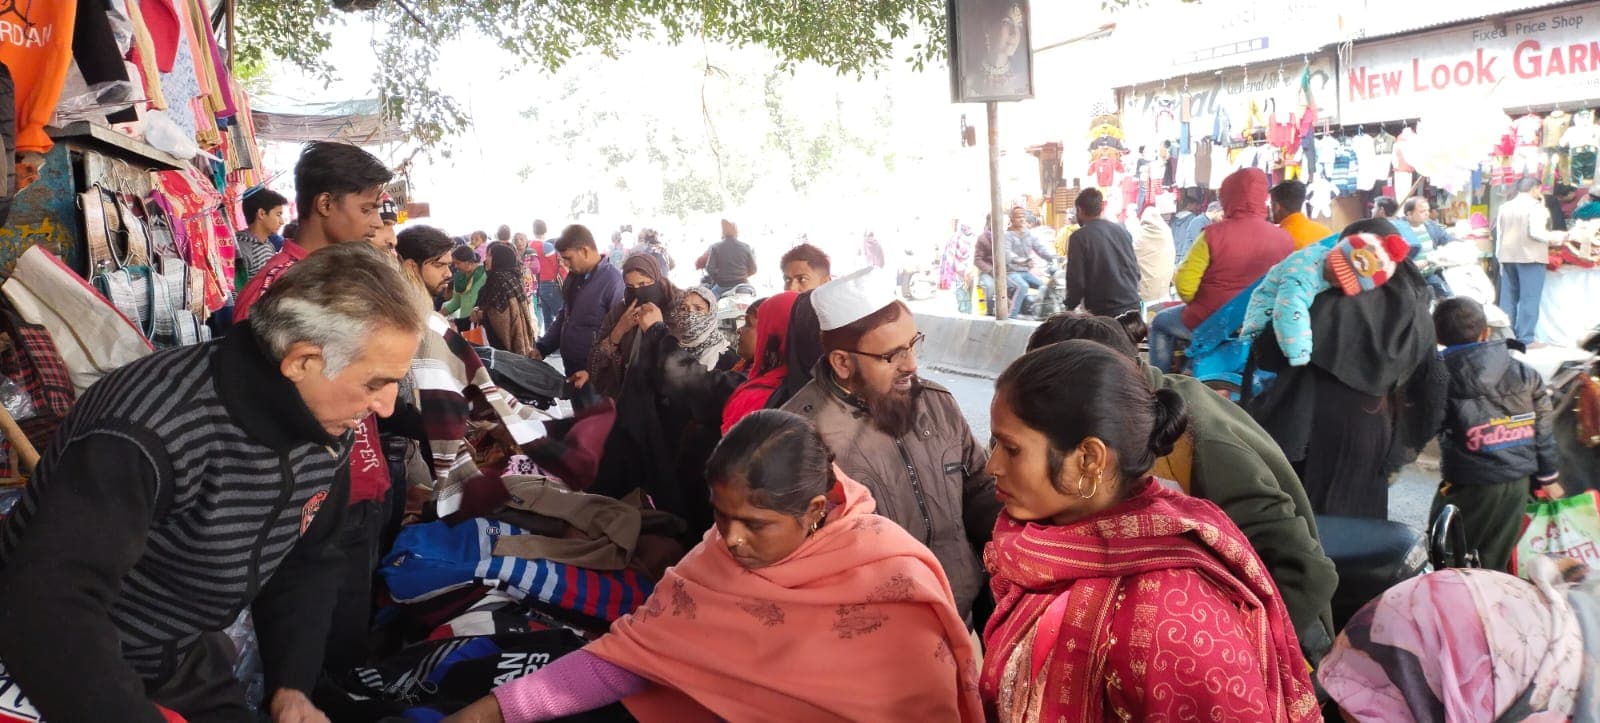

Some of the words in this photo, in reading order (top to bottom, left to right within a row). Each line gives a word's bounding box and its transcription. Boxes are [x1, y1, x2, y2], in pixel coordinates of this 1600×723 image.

[1472, 24, 1508, 42] Fixed
[1515, 21, 1547, 35] Price
[1551, 15, 1584, 29] Shop
[1412, 47, 1498, 93] Look
